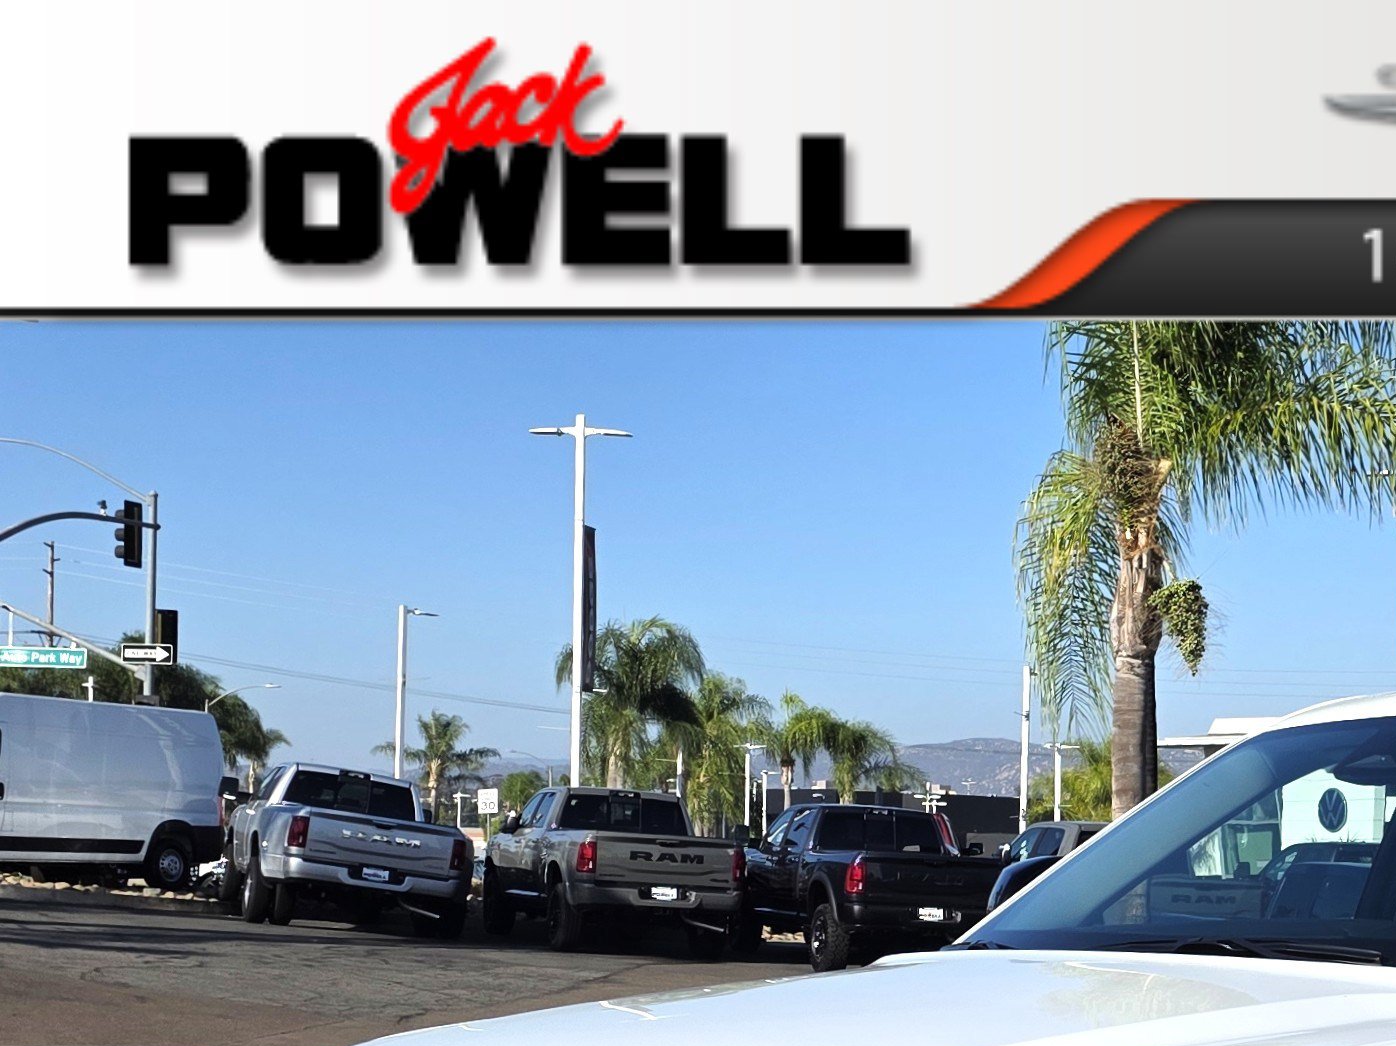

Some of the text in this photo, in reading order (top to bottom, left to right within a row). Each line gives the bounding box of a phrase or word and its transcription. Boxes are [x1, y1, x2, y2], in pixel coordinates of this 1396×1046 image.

[31, 651, 57, 663] Park
[60, 653, 83, 665] Way
[481, 802, 495, 811] 30
[629, 851, 705, 865] RAM
[1171, 894, 1236, 905] RAM
